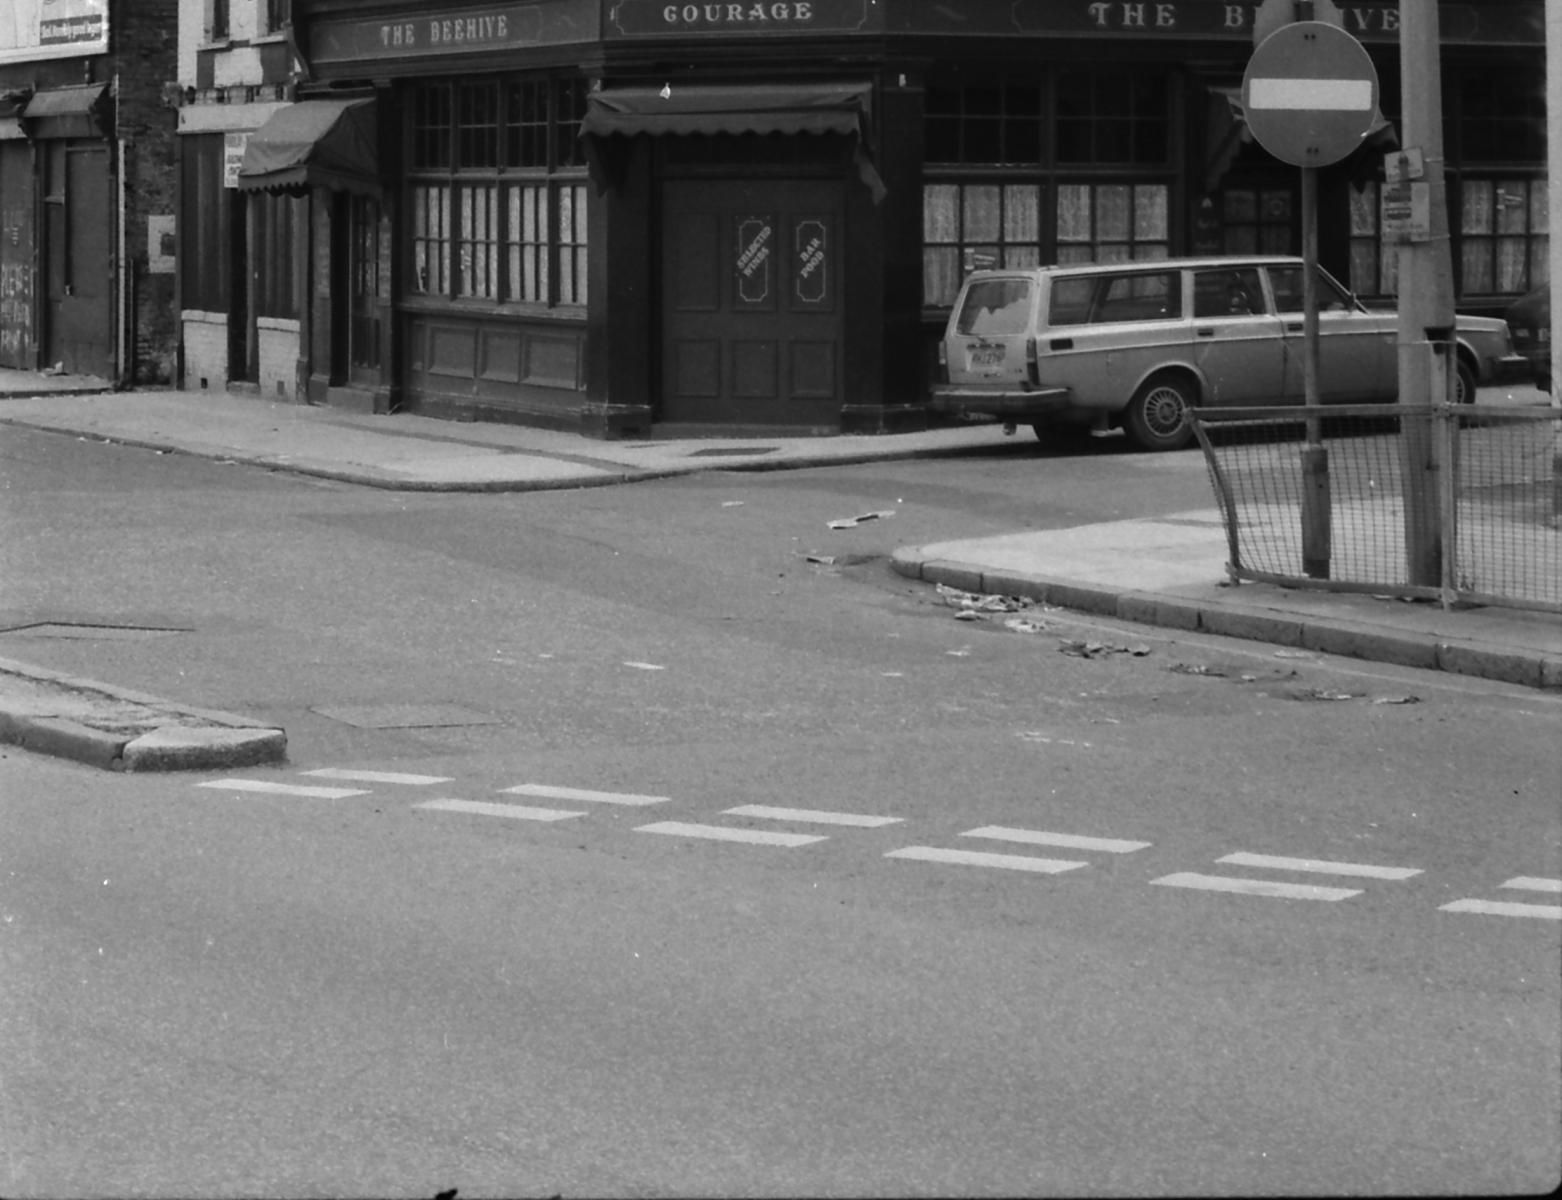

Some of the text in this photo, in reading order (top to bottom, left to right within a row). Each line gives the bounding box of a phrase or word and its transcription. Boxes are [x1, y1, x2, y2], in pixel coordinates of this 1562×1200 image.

[663, 1, 813, 23] COURAGE
[1088, 2, 1401, 31] THE BIVE
[380, 14, 508, 46] THE BEEHIVE
[801, 251, 824, 278] FOOD
